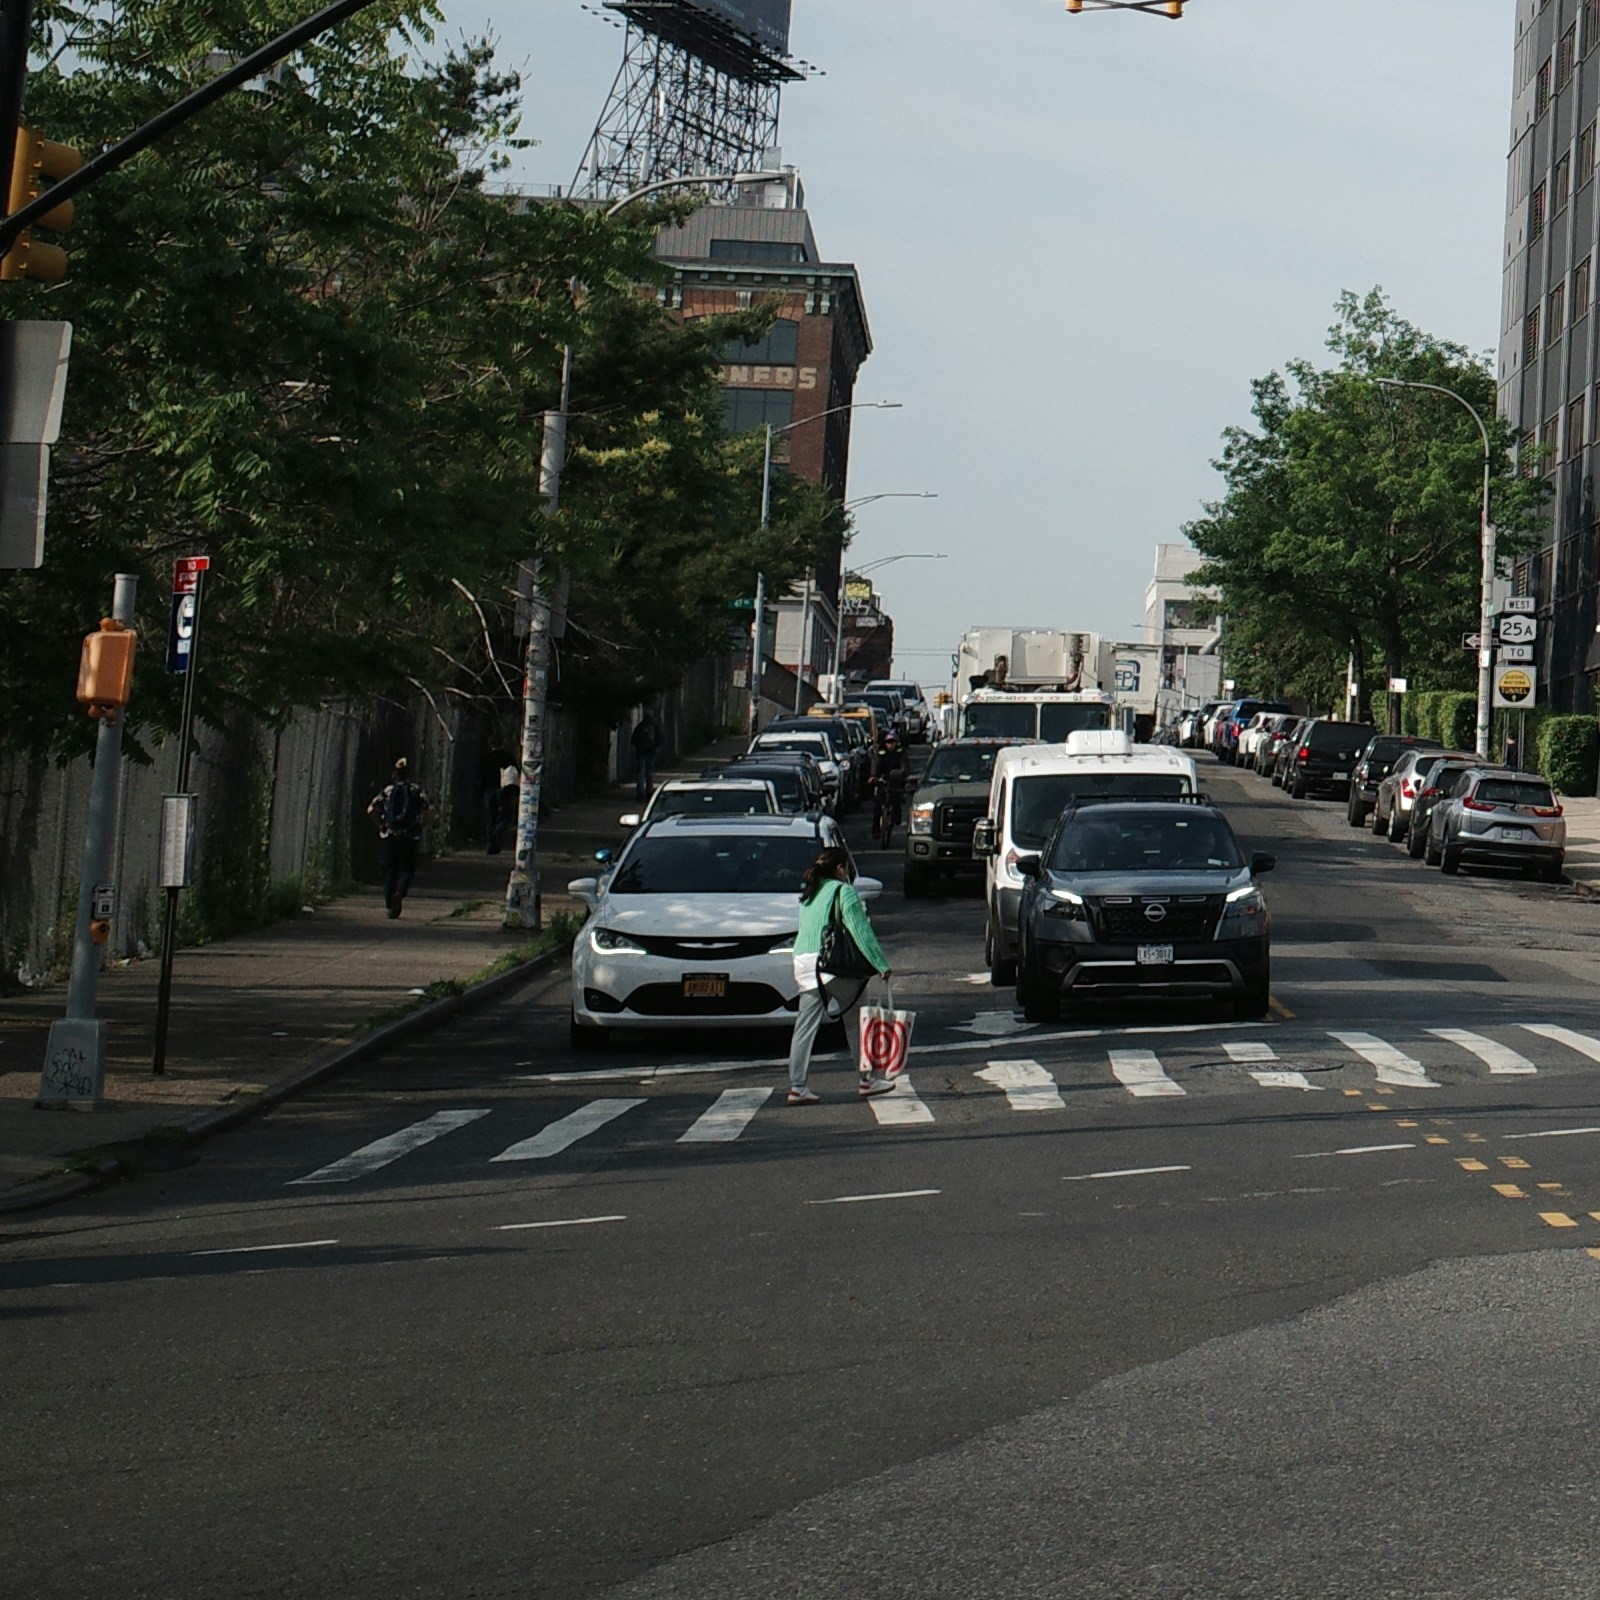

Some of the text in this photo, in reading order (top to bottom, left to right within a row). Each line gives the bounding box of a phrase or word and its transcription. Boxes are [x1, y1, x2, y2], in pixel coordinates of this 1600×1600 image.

[1508, 600, 1531, 610] WEST
[1502, 621, 1533, 636] 25A
[1510, 647, 1525, 657] TO
